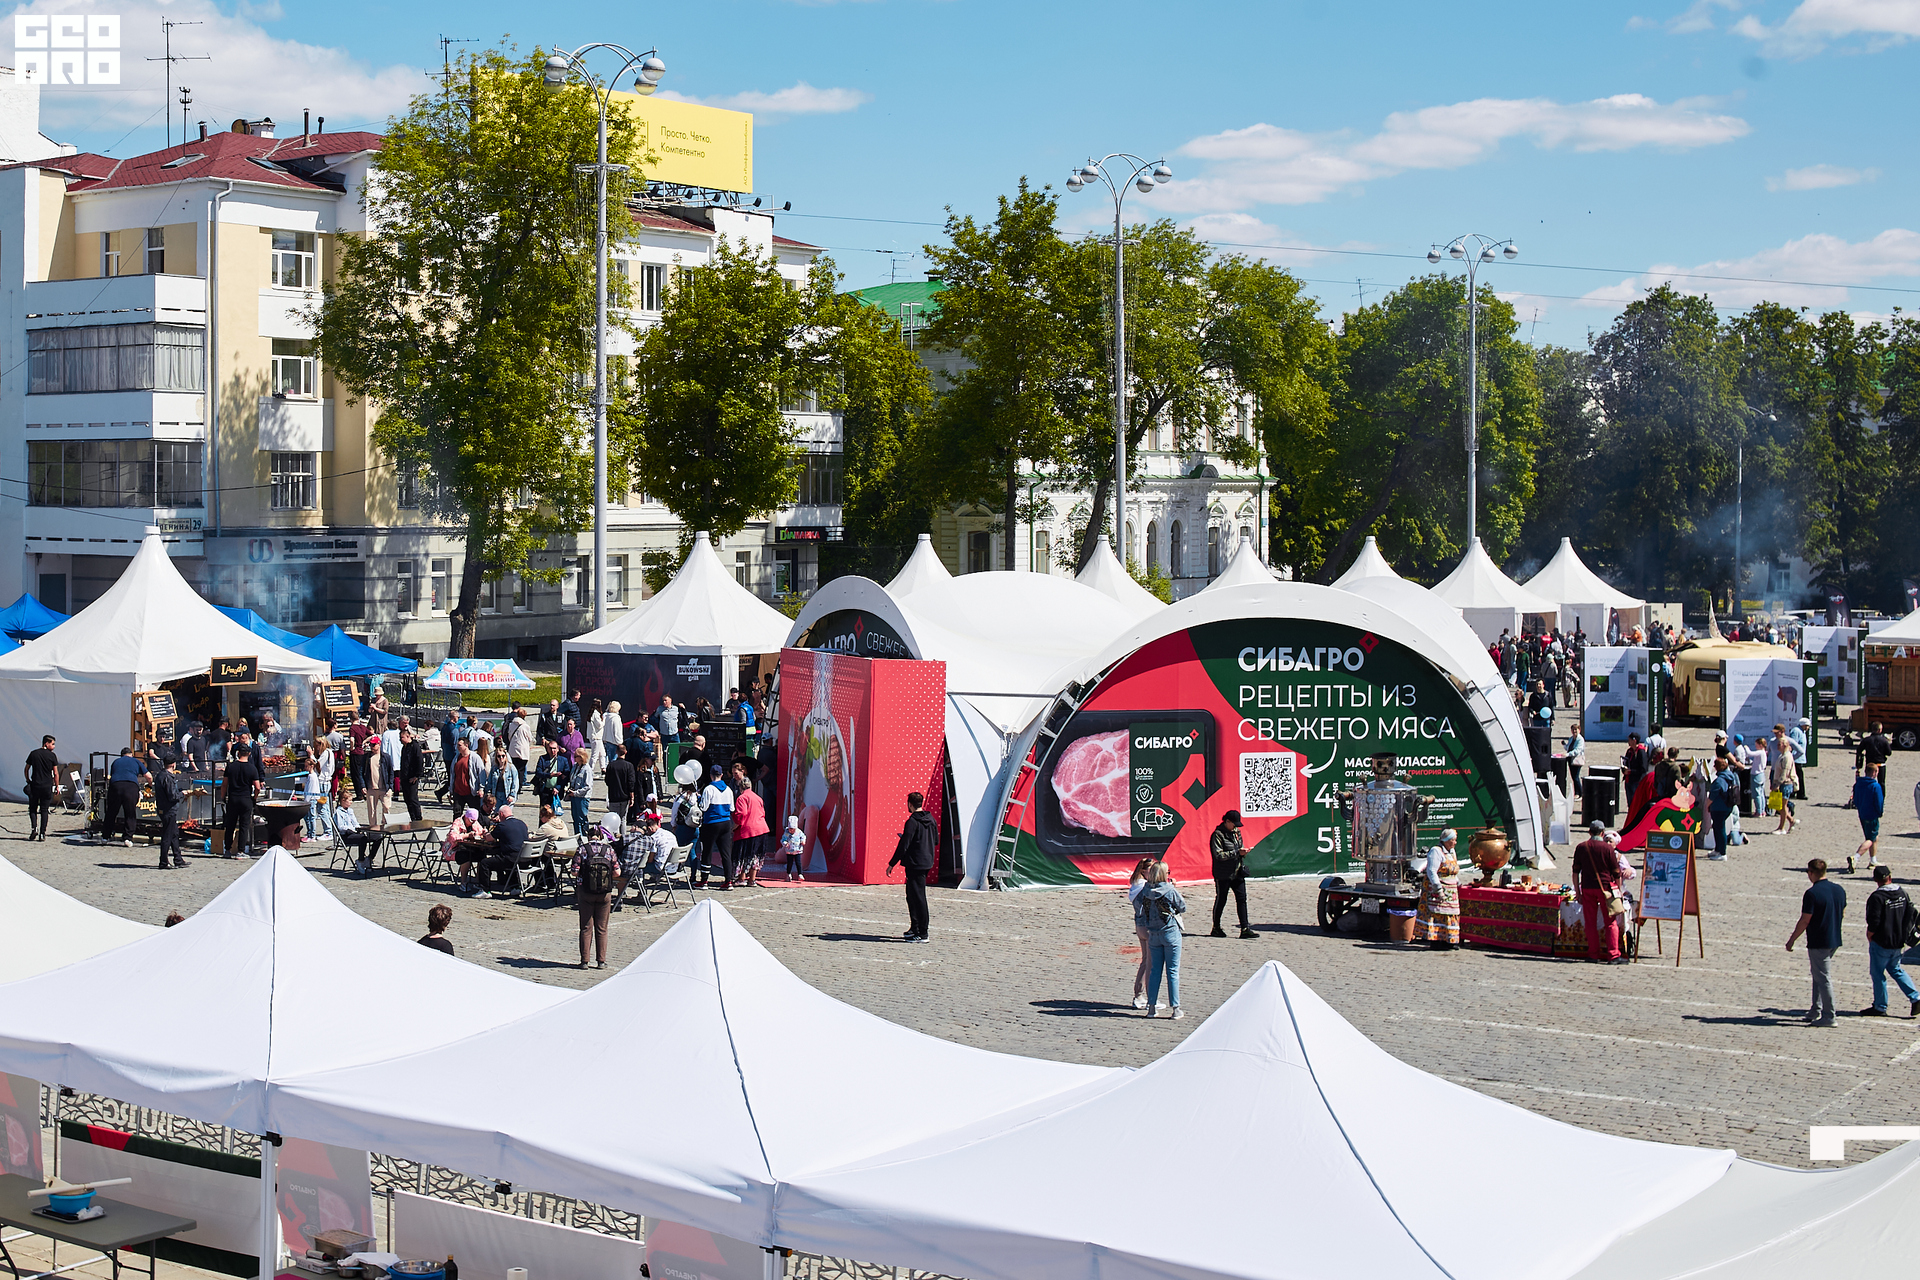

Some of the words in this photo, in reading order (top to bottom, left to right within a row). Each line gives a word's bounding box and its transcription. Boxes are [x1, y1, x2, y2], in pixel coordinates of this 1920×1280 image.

[660, 126, 688, 139] Просто.
[690, 130, 712, 144] Четко.
[660, 142, 706, 158] Компетентно
[193, 520, 202, 530] 29
[335, 539, 358, 549] Банк
[576, 656, 604, 666] ТАКОЙ
[1238, 646, 1364, 672] СИБАГРО
[576, 666, 614, 676] СОЧНЫЙ
[586, 676, 616, 686] ПРОЖА
[1239, 684, 1372, 712] РЕЦЕПТЫ
[1382, 684, 1417, 708] ИЗ
[1238, 717, 1369, 741] СВЕЖЕГО
[1378, 716, 1456, 740] МЯСА
[1135, 736, 1192, 749] СИБАГРО
[1135, 768, 1154, 776] 100%
[1314, 783, 1334, 808] 4
[1316, 826, 1334, 853] 5
